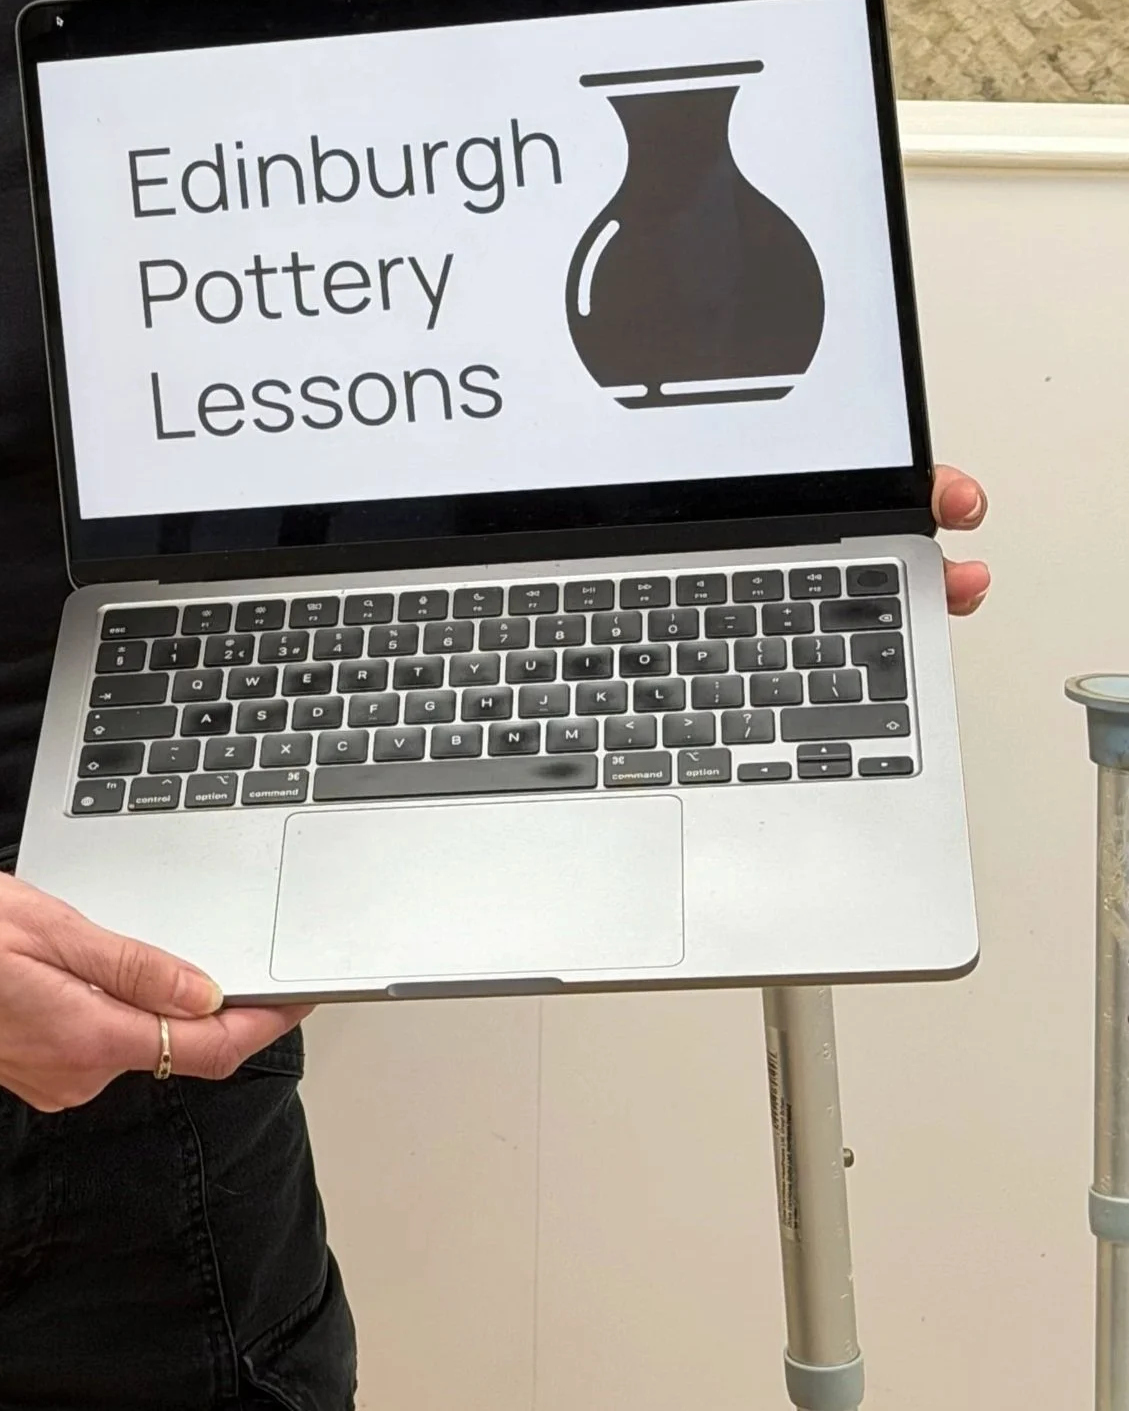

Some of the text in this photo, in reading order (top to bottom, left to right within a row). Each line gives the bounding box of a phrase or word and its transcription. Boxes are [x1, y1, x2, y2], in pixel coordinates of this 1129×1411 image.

[128, 118, 562, 218] Edinburgh
[139, 251, 454, 330] Pottery
[150, 364, 503, 440] Lessons
[108, 626, 127, 635] esc
[170, 652, 177, 663] 1
[223, 649, 234, 661] 2
[277, 645, 289, 657] 3
[332, 643, 343, 653] 4
[387, 639, 398, 650] 5
[442, 636, 454, 647] 6
[499, 633, 509, 644] 7
[554, 629, 566, 641] 8
[610, 626, 622, 638] 9
[667, 623, 679, 635] 0
[191, 679, 204, 691] Q
[245, 676, 261, 687] W
[302, 672, 313, 684] E
[356, 669, 368, 681] R
[413, 666, 424, 678] T
[469, 662, 480, 675] Y
[524, 660, 537, 672] U
[584, 657, 590, 668] I
[638, 653, 652, 666] O
[696, 650, 708, 662] P
[200, 713, 213, 725] A
[256, 709, 268, 722] S
[312, 706, 324, 718] D
[368, 703, 379, 715] F
[424, 700, 436, 712] G
[480, 697, 493, 709] H
[538, 694, 549, 706] J
[595, 691, 607, 703] K
[654, 688, 665, 700] L
[223, 746, 236, 758] Z
[280, 743, 292, 755] X
[336, 740, 349, 752] C
[393, 737, 406, 749] V
[451, 734, 462, 746] B
[508, 731, 521, 743] N
[565, 728, 579, 740] M
[105, 767, 720, 805] fn control option command command option
